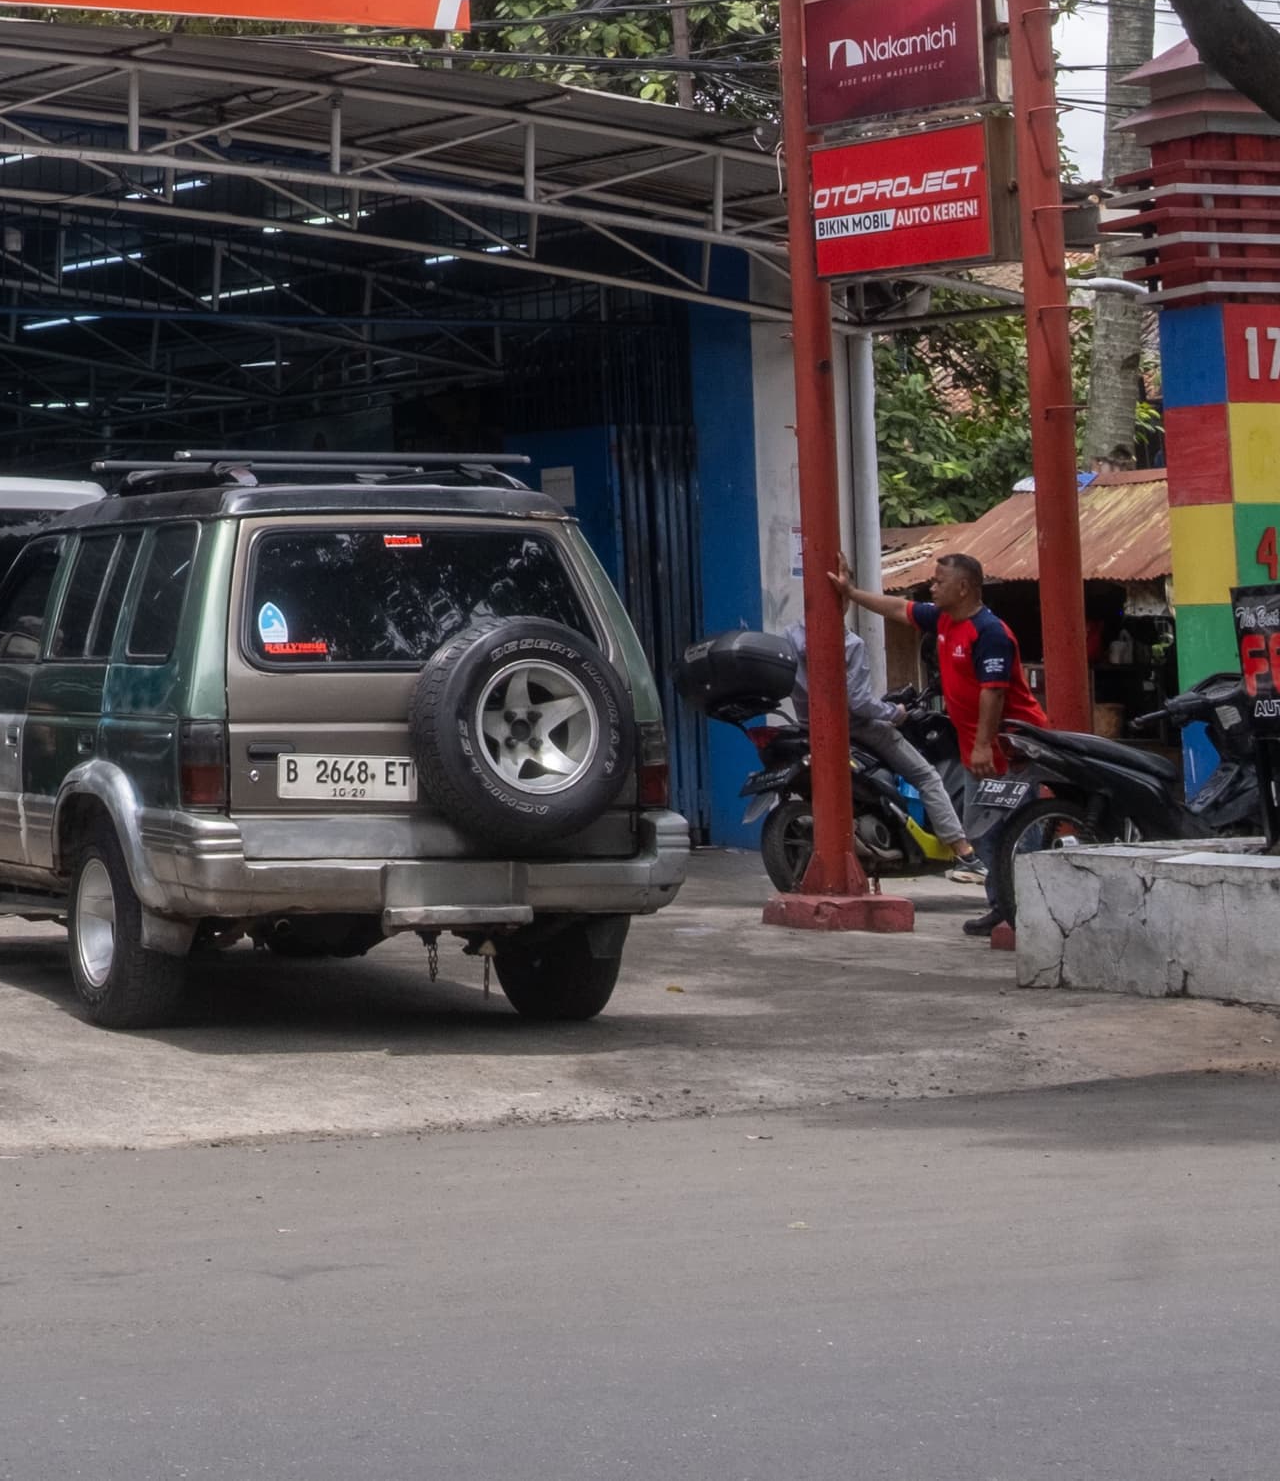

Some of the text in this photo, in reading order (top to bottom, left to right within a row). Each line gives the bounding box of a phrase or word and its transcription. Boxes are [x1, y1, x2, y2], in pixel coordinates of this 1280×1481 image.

[863, 22, 957, 63] Nakamichi
[813, 165, 978, 210] OTOPROJECT
[818, 199, 978, 237] BIKIN MOBIL AUTO KEREN!
[490, 638, 581, 662] DESERT
[286, 758, 299, 783] B
[315, 759, 369, 784] 2648
